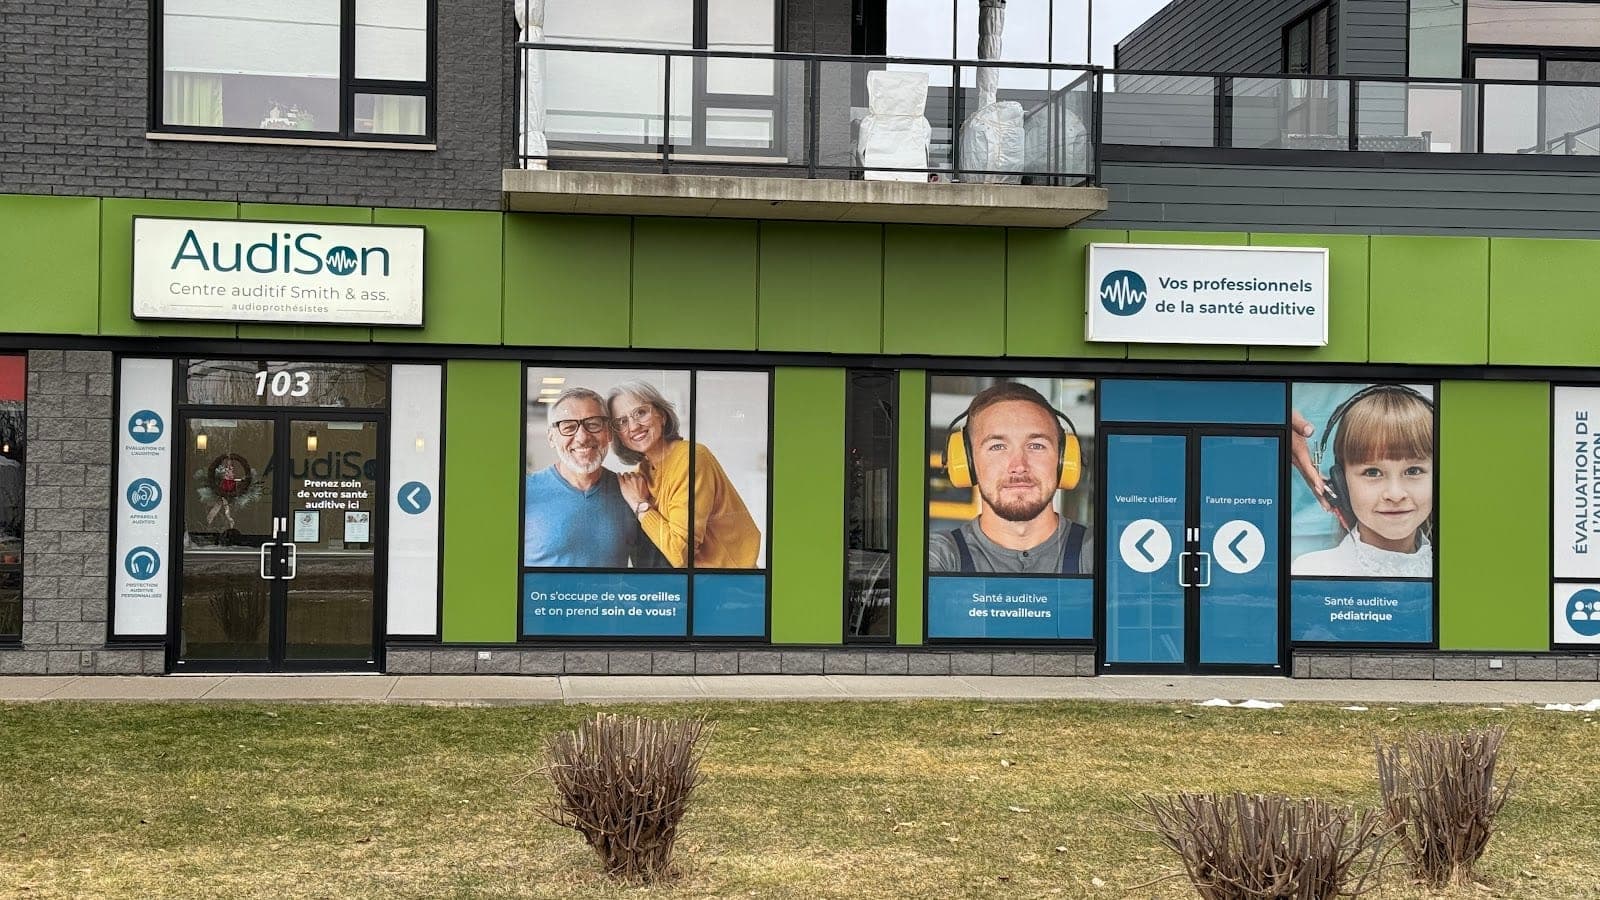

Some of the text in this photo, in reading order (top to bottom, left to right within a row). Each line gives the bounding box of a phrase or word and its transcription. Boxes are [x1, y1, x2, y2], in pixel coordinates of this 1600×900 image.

[170, 229, 390, 277] AudiSon
[1159, 277, 1313, 293] Vos professionnels
[169, 282, 390, 301] Centre auditif Smith & ass.
[231, 302, 329, 313] audioprothésistes
[1155, 301, 1316, 316] de la santé auditive
[255, 371, 311, 397] 103
[304, 480, 361, 488] Prenez soin
[1572, 411, 1588, 554] ÉVALUATION DE
[297, 490, 368, 499] de votre santé
[1115, 495, 1177, 504] Veuillez utiliser
[305, 501, 359, 509] auditive ici
[1205, 496, 1273, 506] l'autre porte svp
[530, 592, 681, 604] On s'occupe de vos oreilles
[972, 593, 1047, 604] Santé auditive
[1324, 596, 1398, 607] Santé auditive
[534, 607, 676, 619] et on prend soin de vous!
[969, 608, 1051, 618] des travailleurs
[1330, 611, 1393, 622] pédiatrique
